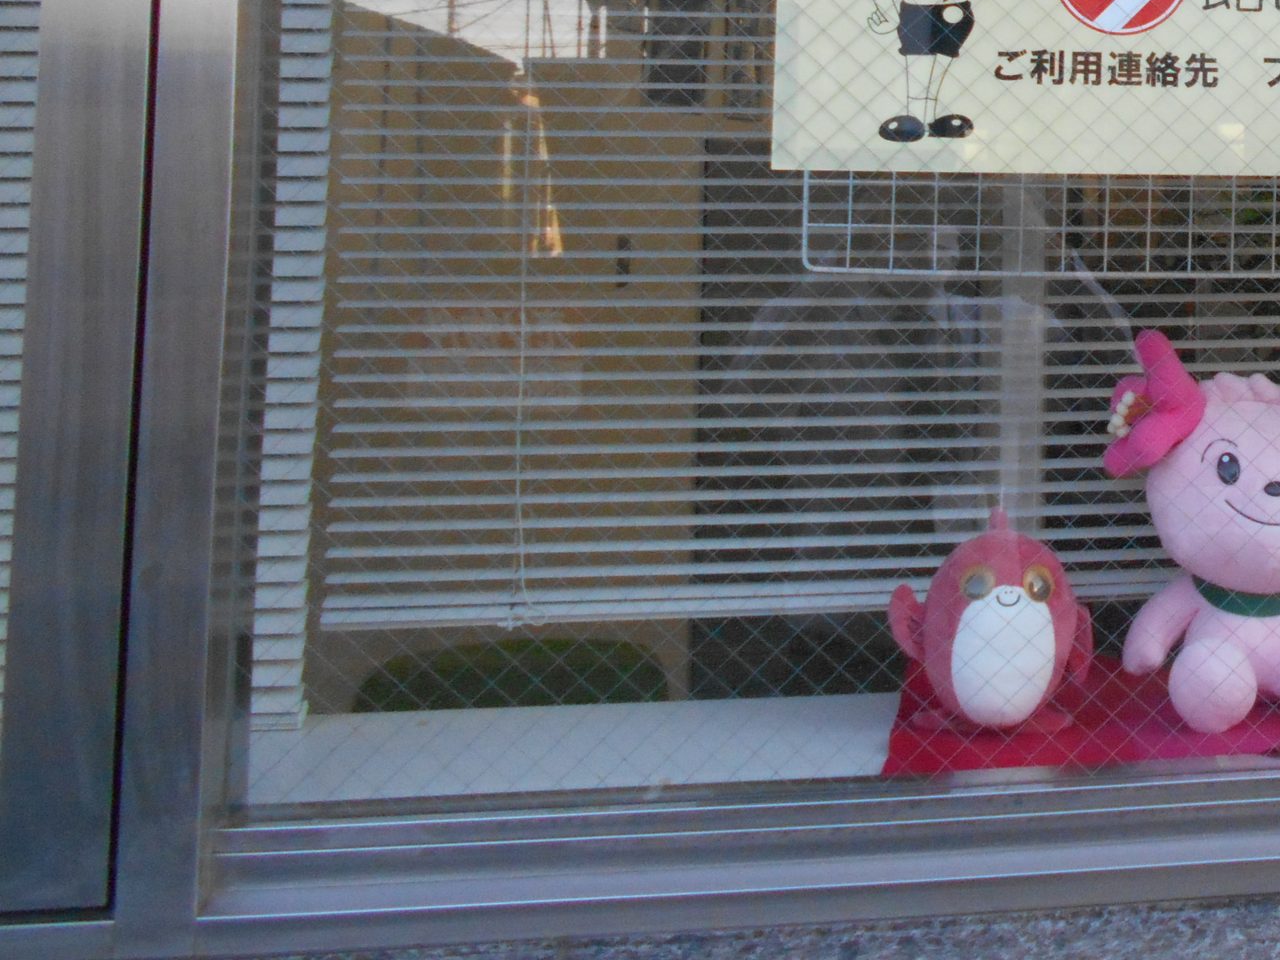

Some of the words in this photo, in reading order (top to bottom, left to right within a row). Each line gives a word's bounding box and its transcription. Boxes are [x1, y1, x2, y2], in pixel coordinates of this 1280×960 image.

[994, 49, 1219, 88] ご利用連絡先
